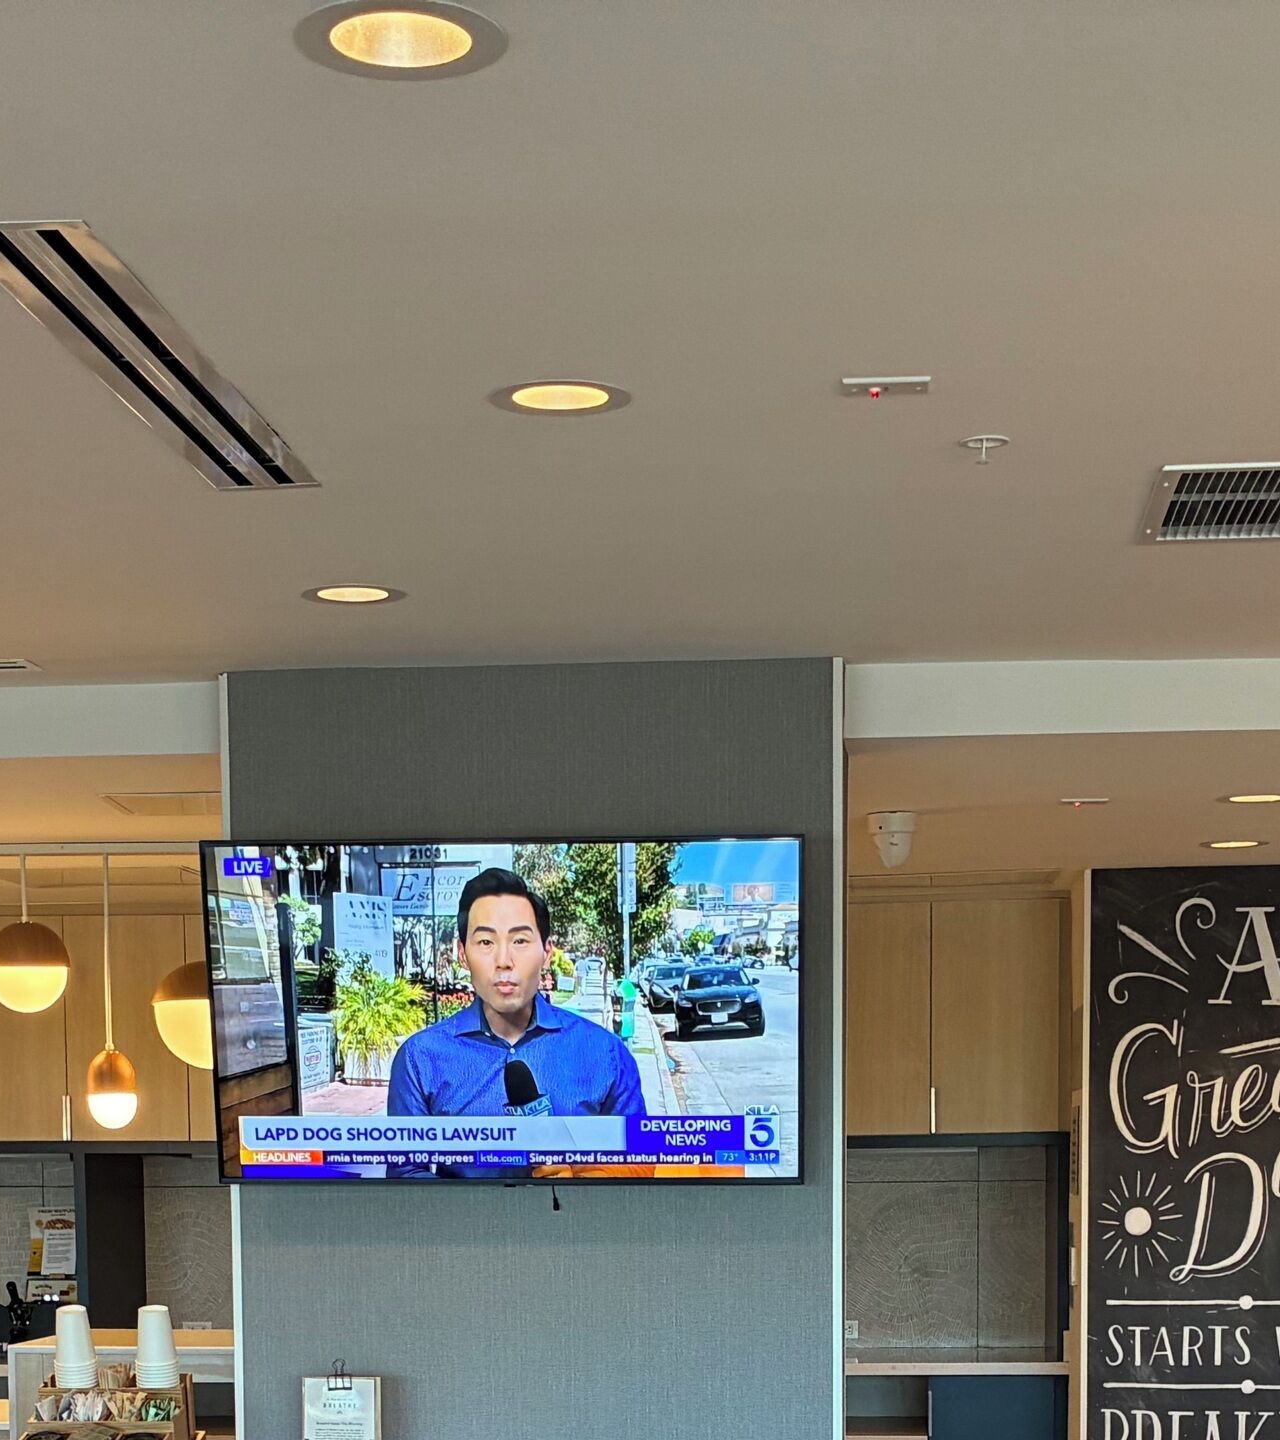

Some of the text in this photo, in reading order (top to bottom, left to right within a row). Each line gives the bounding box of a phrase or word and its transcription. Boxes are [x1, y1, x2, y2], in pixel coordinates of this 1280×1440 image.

[233, 860, 264, 874] LIVE
[743, 1104, 780, 1115] KTLA
[640, 1119, 732, 1132] DEVELOPING
[254, 1127, 517, 1142] LAPD DOG SHOOTING LAWSUIT
[748, 1117, 775, 1148] 5
[665, 1134, 707, 1146] NEWS
[252, 1152, 312, 1163] HEADLINES
[326, 1153, 474, 1165] rnia temps top 100 degrees
[480, 1153, 523, 1163] ktla.com
[529, 1153, 712, 1165] Singer D4vd faces status hearing in
[748, 1153, 776, 1162] 3:11P
[1104, 1324, 1252, 1367] STARTS
